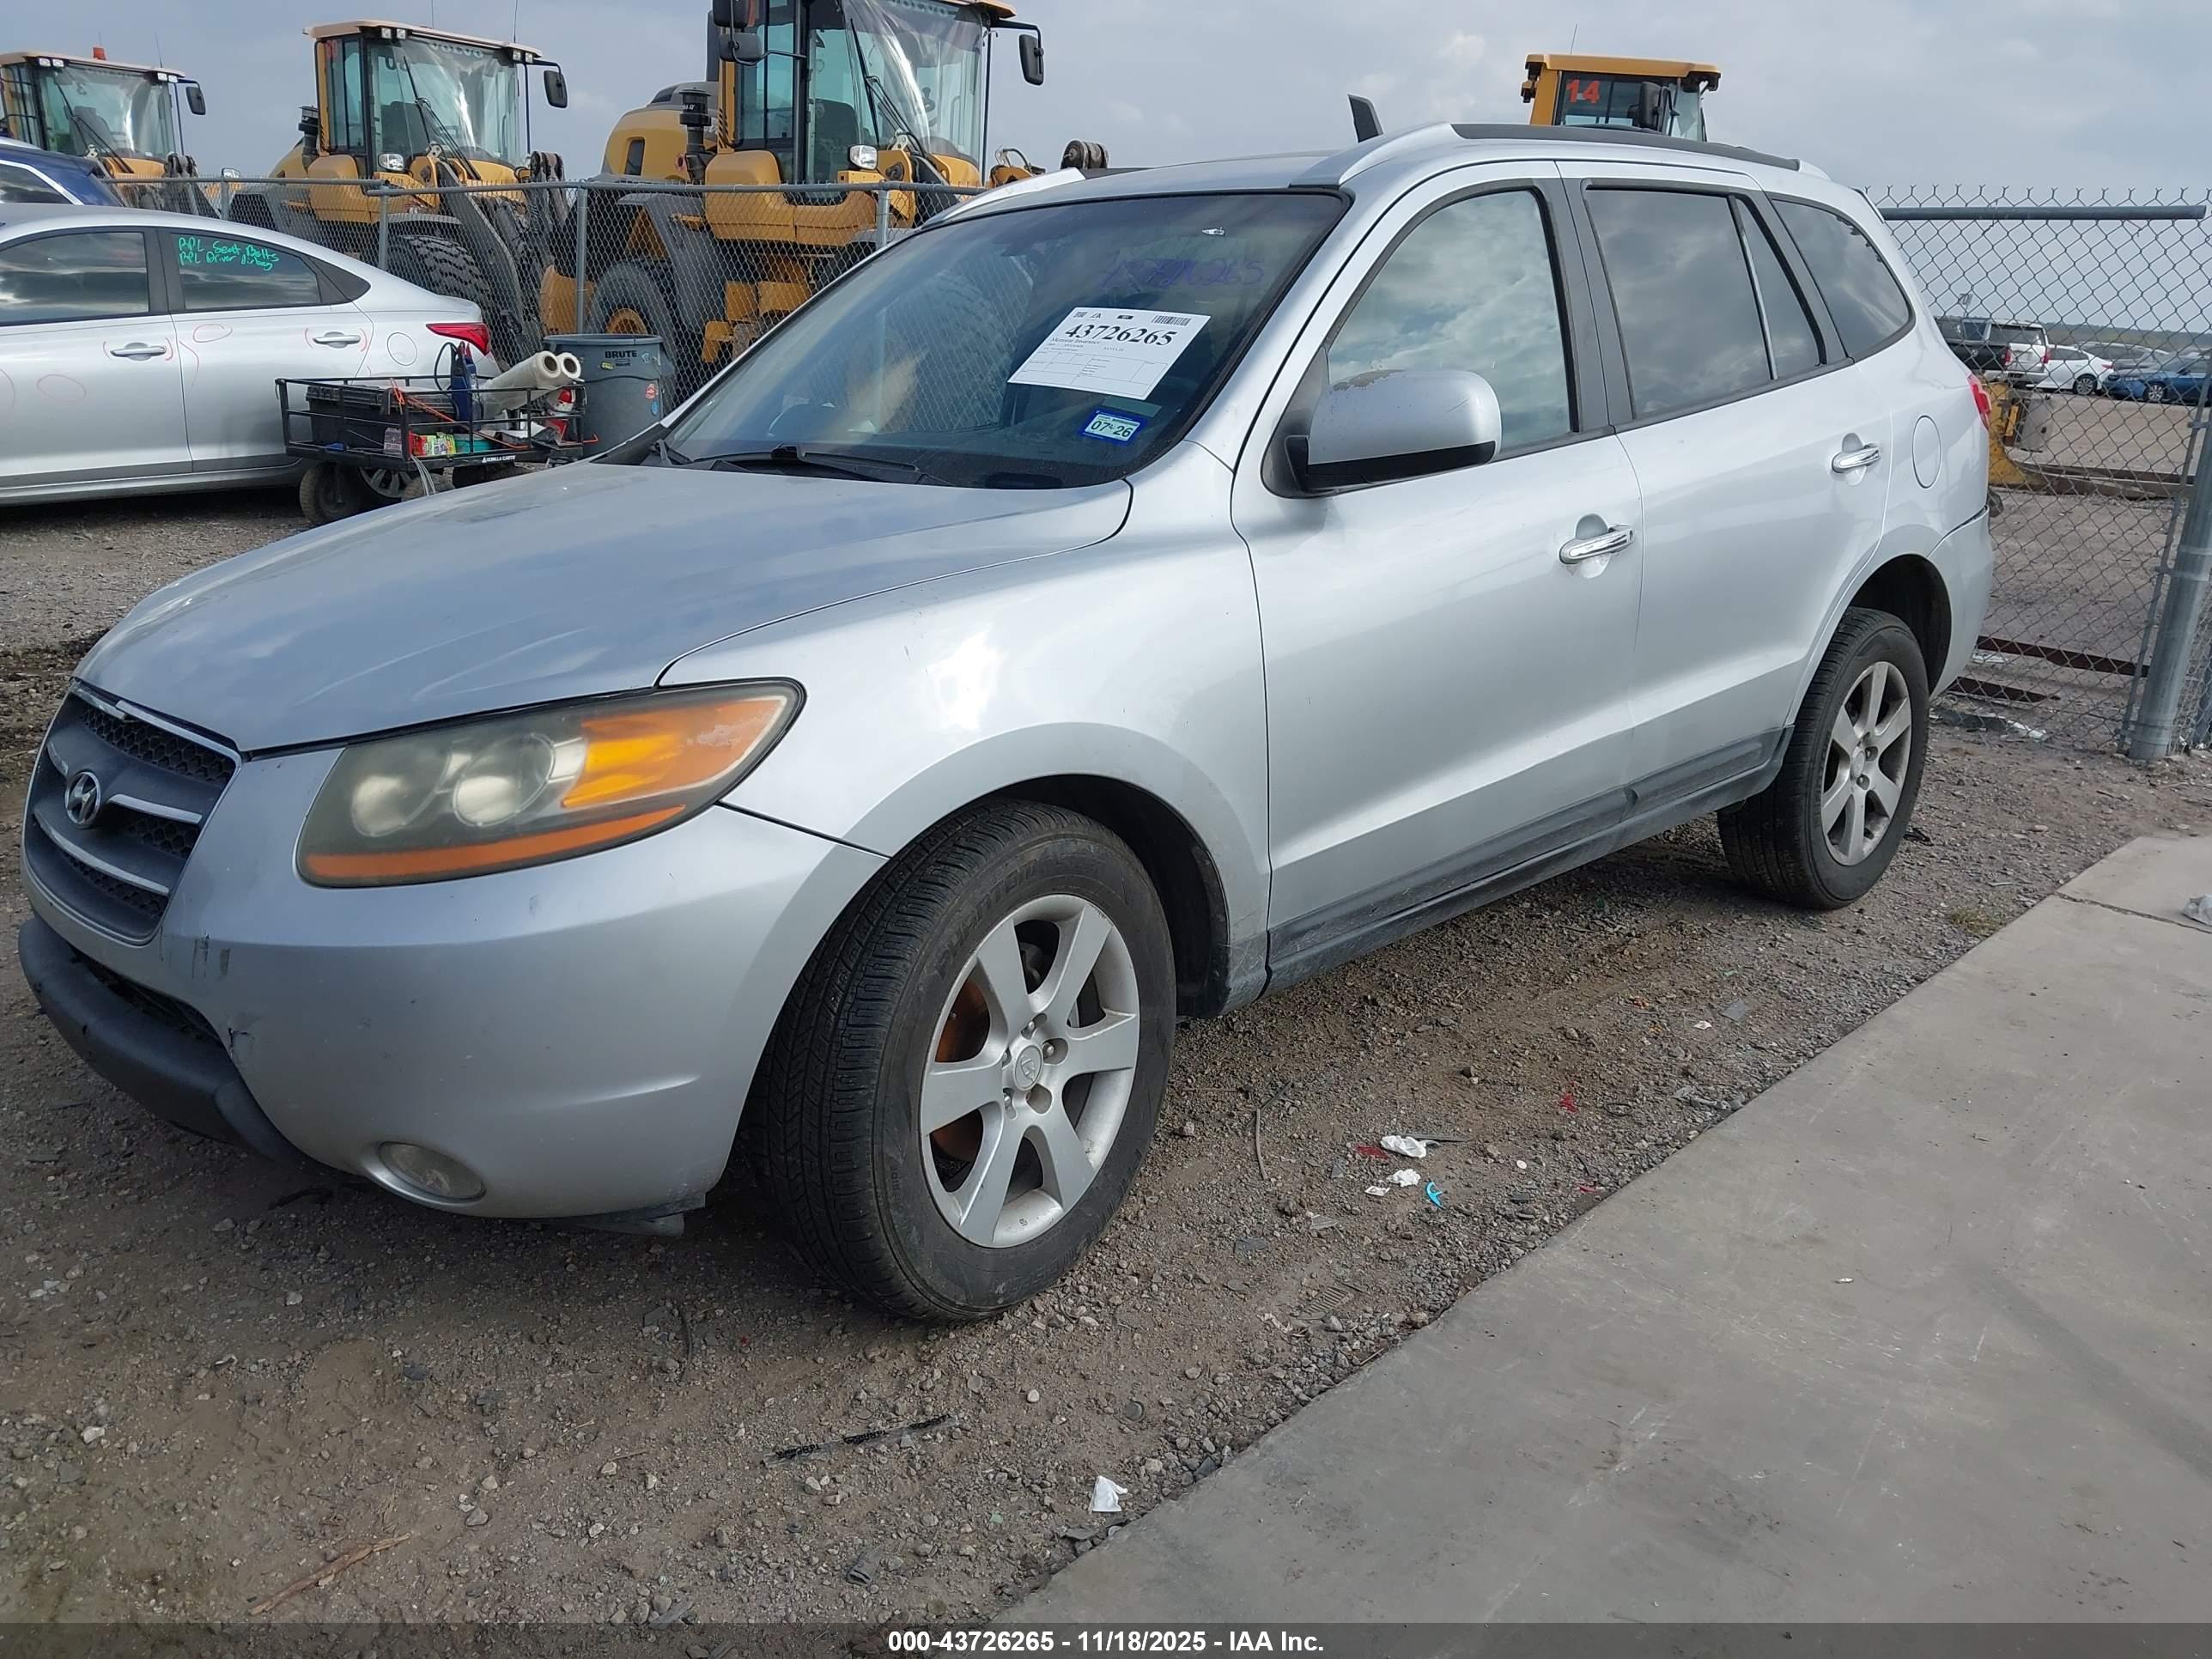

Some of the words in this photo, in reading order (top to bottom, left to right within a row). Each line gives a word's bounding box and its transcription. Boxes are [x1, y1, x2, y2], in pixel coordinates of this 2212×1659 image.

[431, 44, 484, 58] VOLVO
[1566, 78, 1601, 104] 14
[1065, 324, 1178, 346] 43726265
[605, 350, 638, 359] BRUTE
[1091, 421, 1111, 432] 07
[1113, 425, 1133, 438] 26
